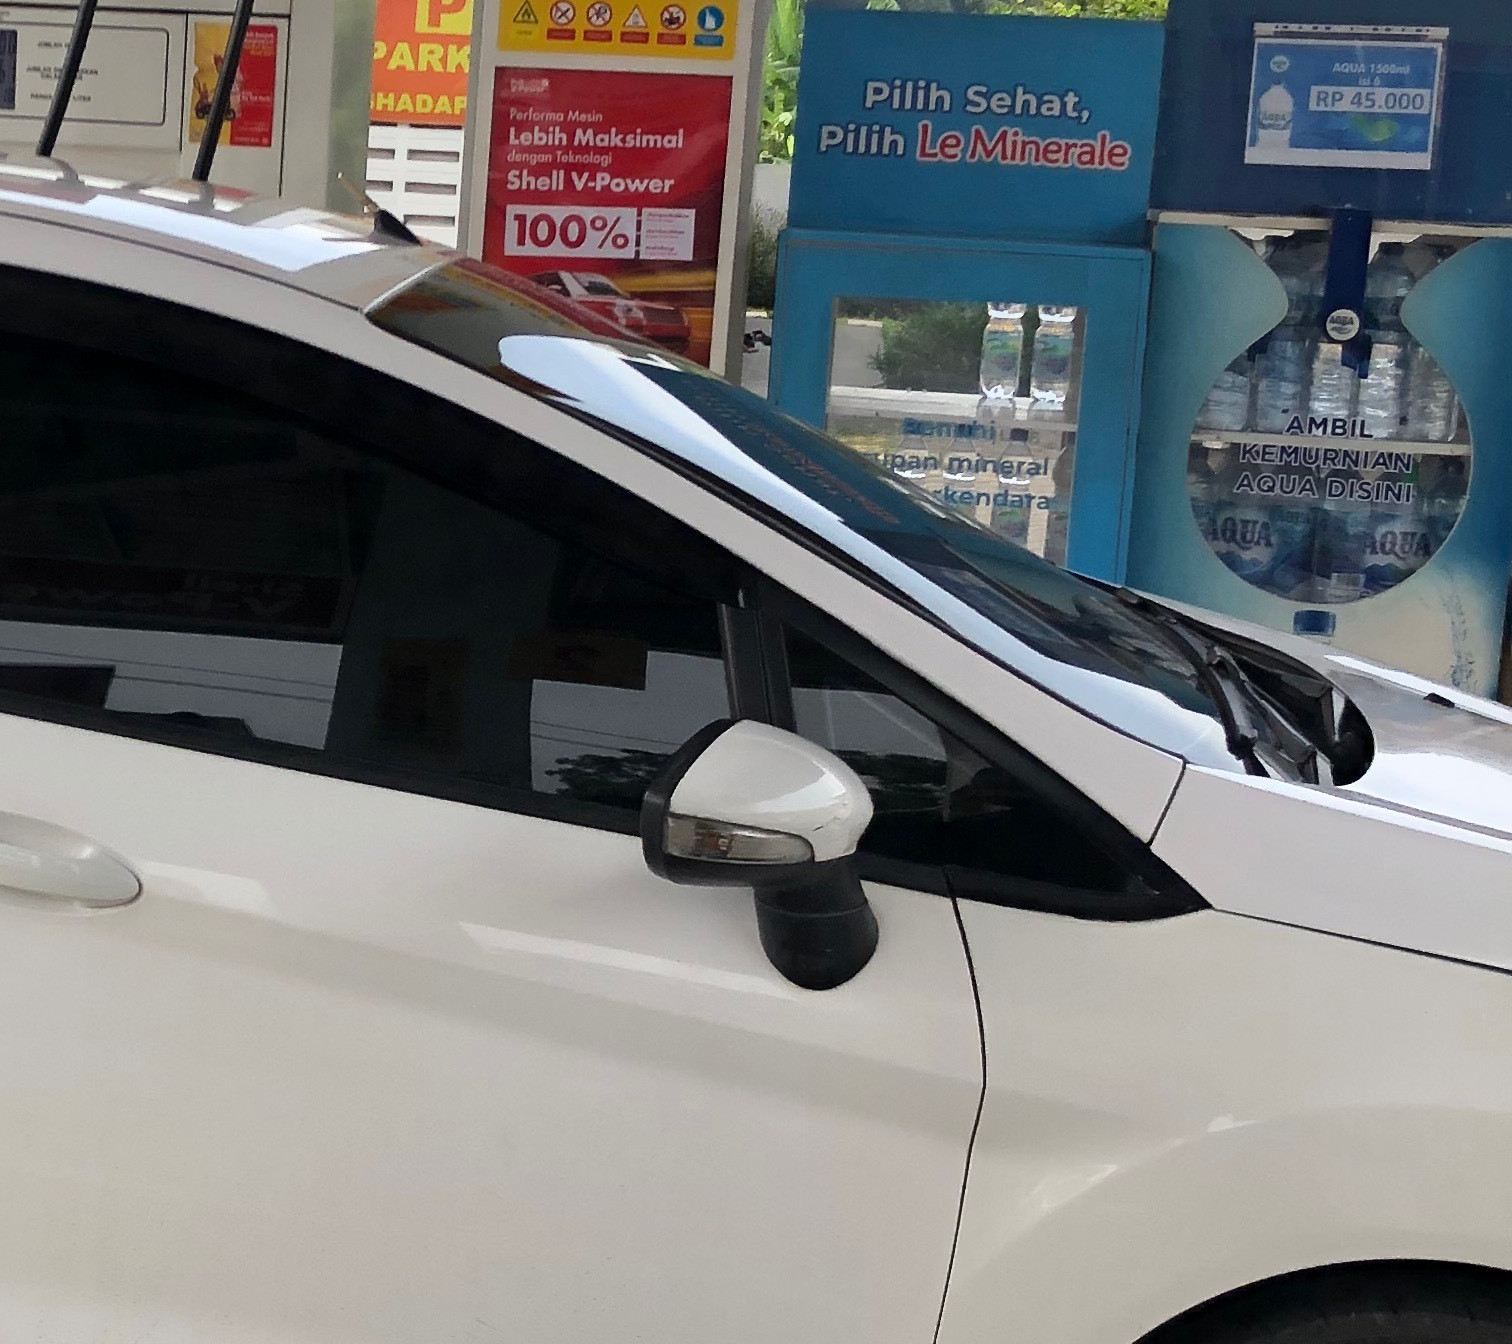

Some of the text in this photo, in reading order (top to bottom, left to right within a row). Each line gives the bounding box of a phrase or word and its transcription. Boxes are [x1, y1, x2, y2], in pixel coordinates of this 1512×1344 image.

[1332, 62, 1366, 74] AQUA
[370, 92, 468, 115] HADAP
[864, 79, 1091, 123] Pilih Sehat,
[1316, 90, 1426, 111] RP 45.000
[509, 107, 603, 123] Performa Mesin
[509, 127, 684, 149] Lebih Maksimal
[819, 120, 1131, 172] Pilih Le Minerale
[507, 151, 613, 167] dengan Teknologi
[506, 169, 675, 193] Shell V-Power
[513, 213, 630, 250] 100%
[1284, 414, 1374, 439] AMBIL
[947, 453, 1049, 477] mineral
[1239, 443, 1413, 474] KEMURNIAN
[1234, 472, 1414, 504] AQUA DISINI
[1205, 516, 1273, 550] AQUA
[1362, 530, 1432, 560] AQUA
